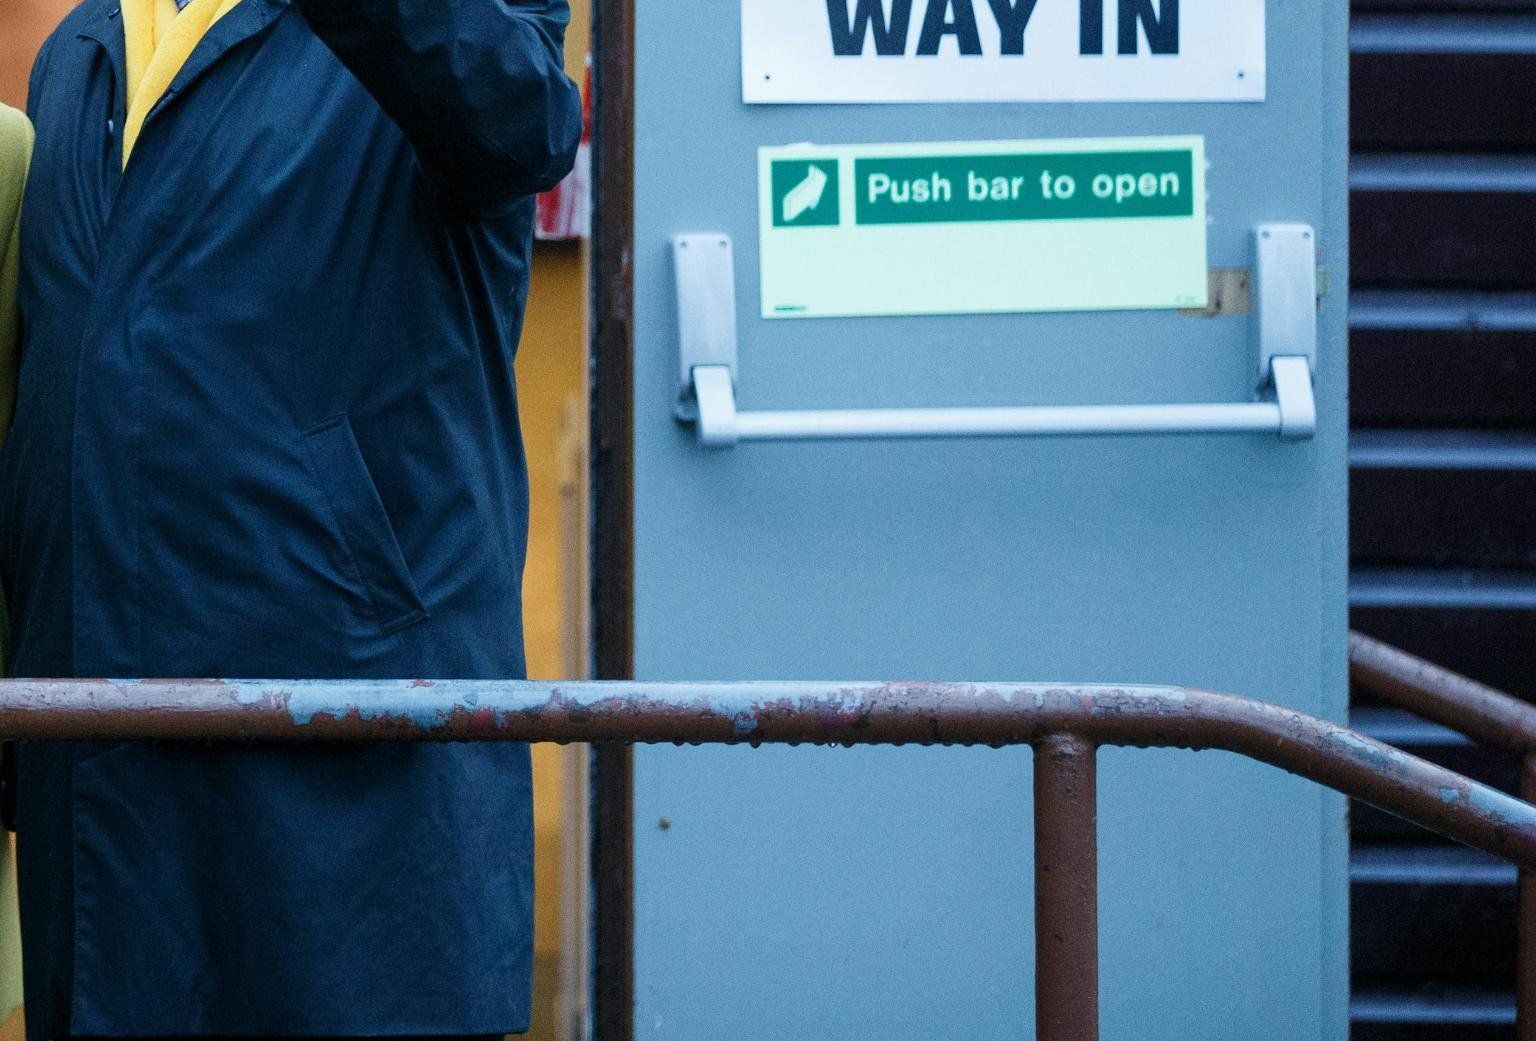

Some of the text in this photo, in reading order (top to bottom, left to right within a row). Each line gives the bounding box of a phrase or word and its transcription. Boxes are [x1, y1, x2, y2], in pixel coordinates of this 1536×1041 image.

[868, 170, 1181, 204] Push bar to open
